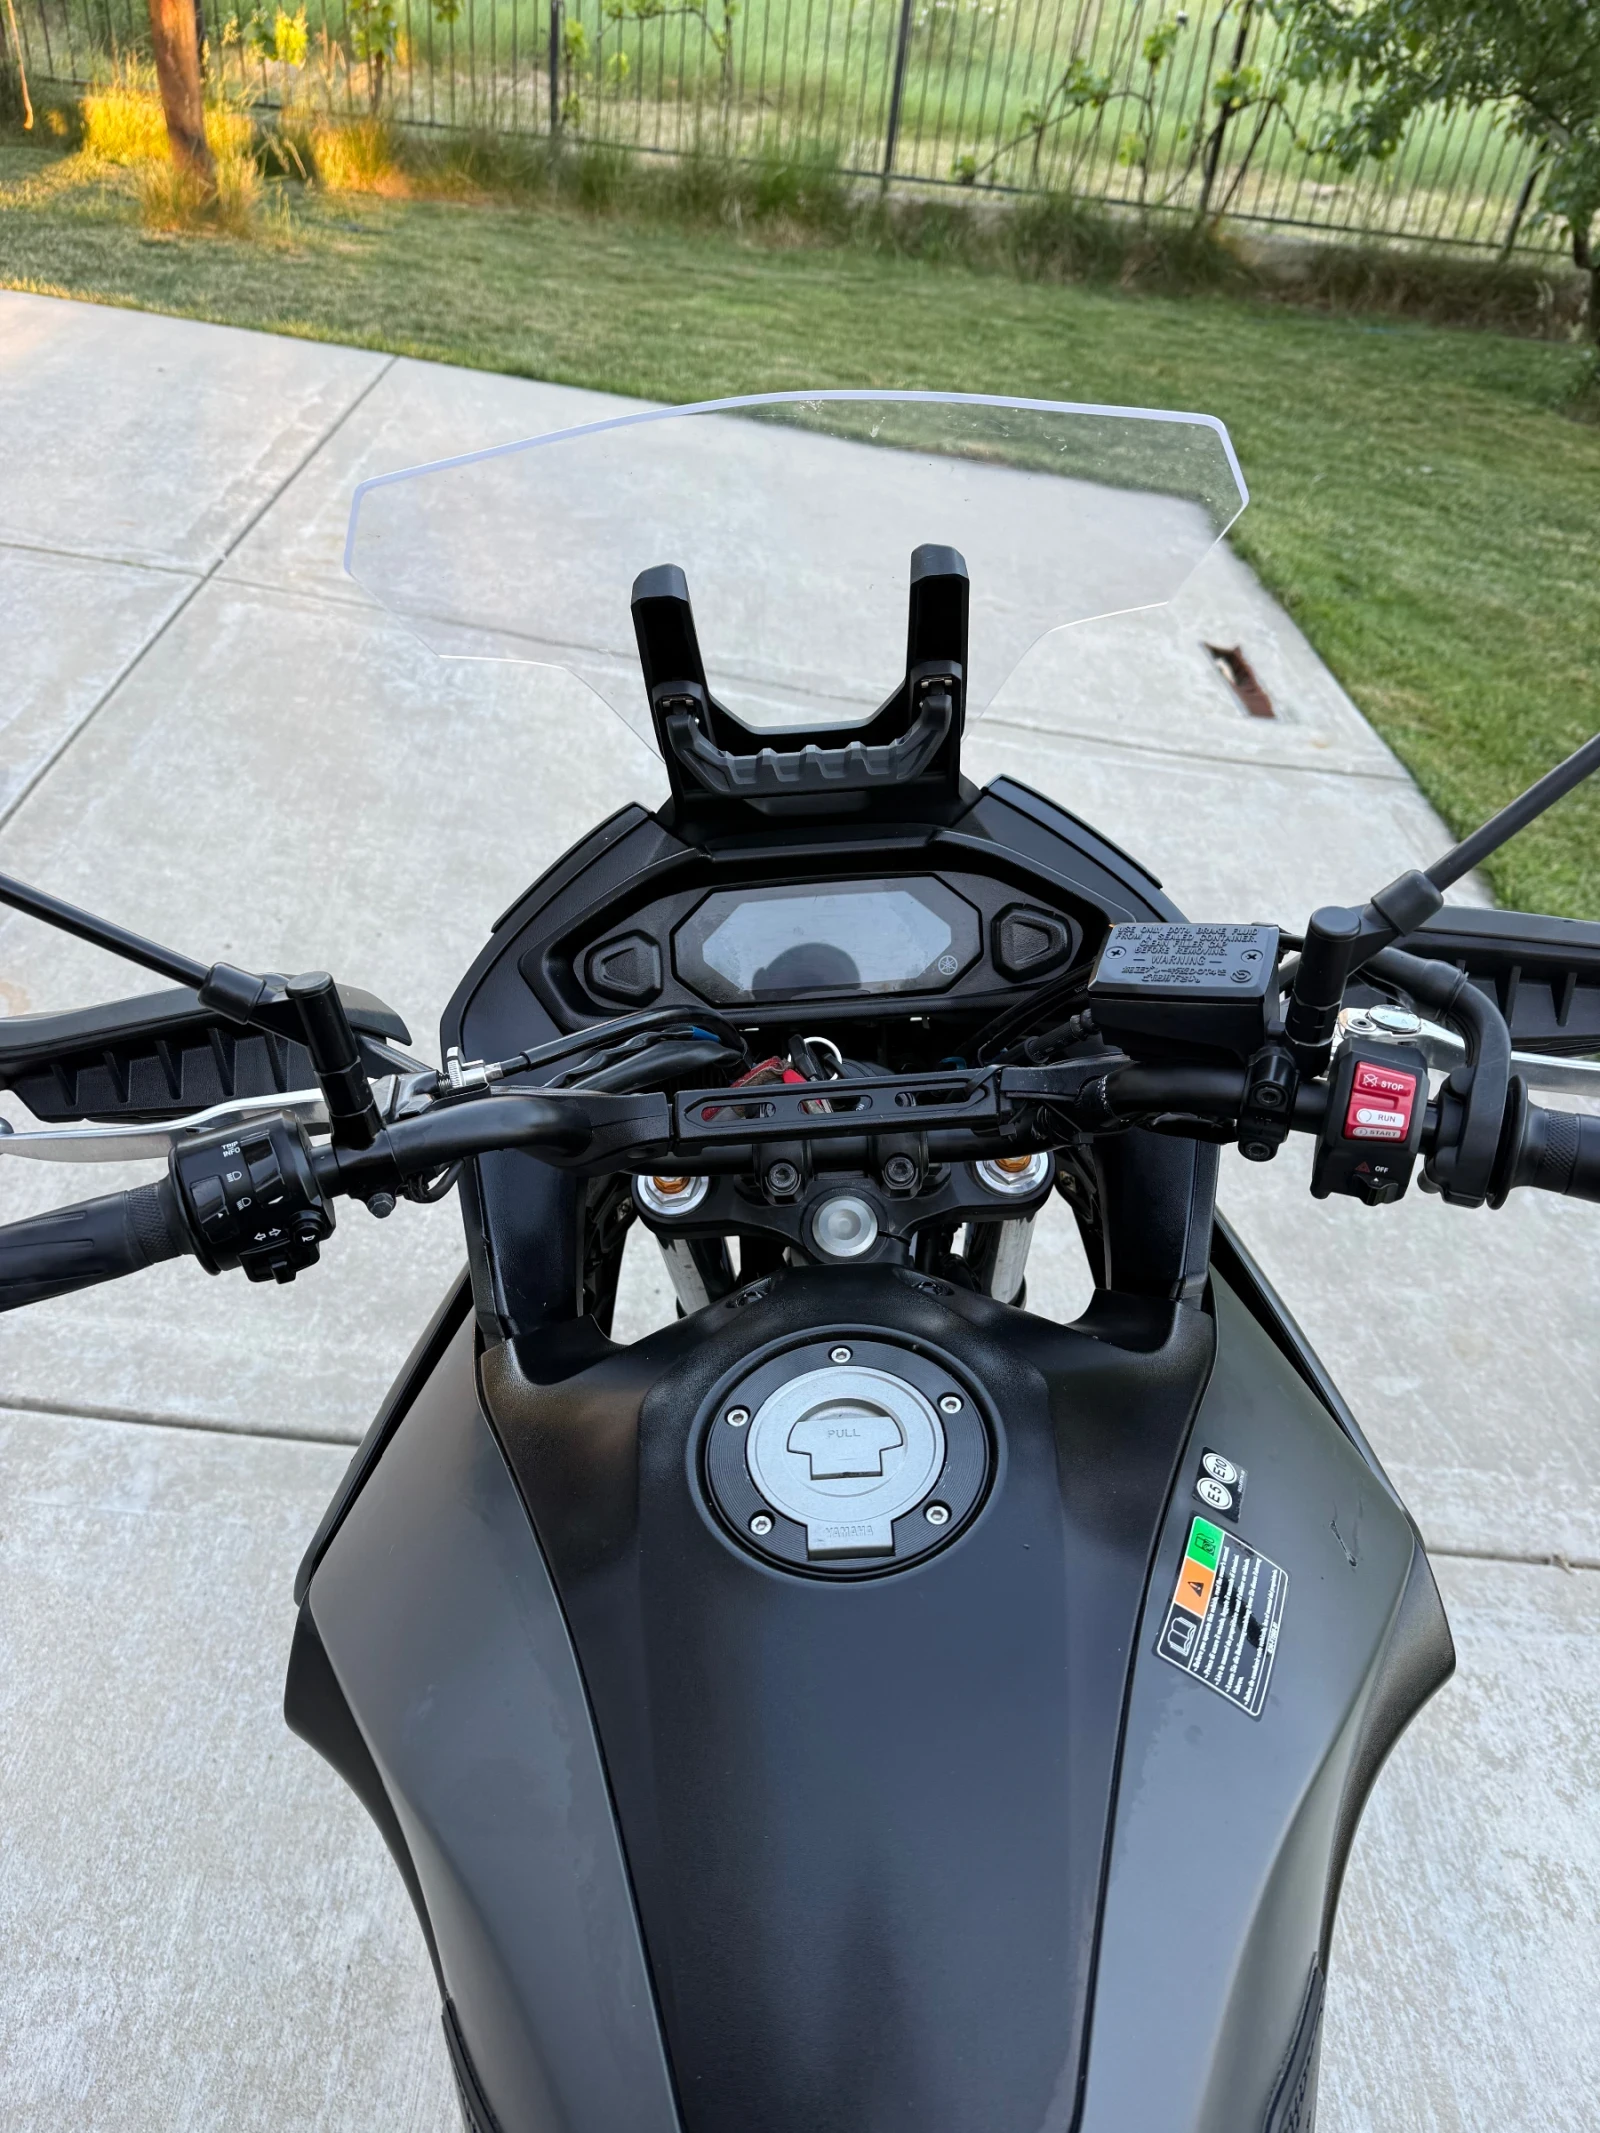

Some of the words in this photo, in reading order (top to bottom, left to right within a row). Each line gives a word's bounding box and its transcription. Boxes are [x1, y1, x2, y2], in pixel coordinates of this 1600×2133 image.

[1140, 926, 1161, 934] ONLY
[1195, 926, 1227, 935] BRAKE
[1231, 928, 1260, 936] FLUID
[1157, 933, 1194, 941] SEALED
[1199, 934, 1257, 943] CONTAINER.
[1139, 940, 1168, 948] CLEAN
[1172, 940, 1203, 948] FILLER
[1208, 941, 1227, 949] CAP
[1174, 947, 1228, 956] REMOVING.
[1151, 955, 1206, 965] WARNING
[1380, 1080, 1404, 1091] STOP
[1377, 1113, 1396, 1123] RUN
[221, 1141, 239, 1149] TRIP
[223, 1146, 241, 1157] INFO
[1374, 1165, 1389, 1173] OFF
[827, 1428, 861, 1438] PULL
[1213, 1458, 1227, 1478] E10
[1207, 1483, 1222, 1503] E5
[825, 1525, 874, 1538] YAMAHA
